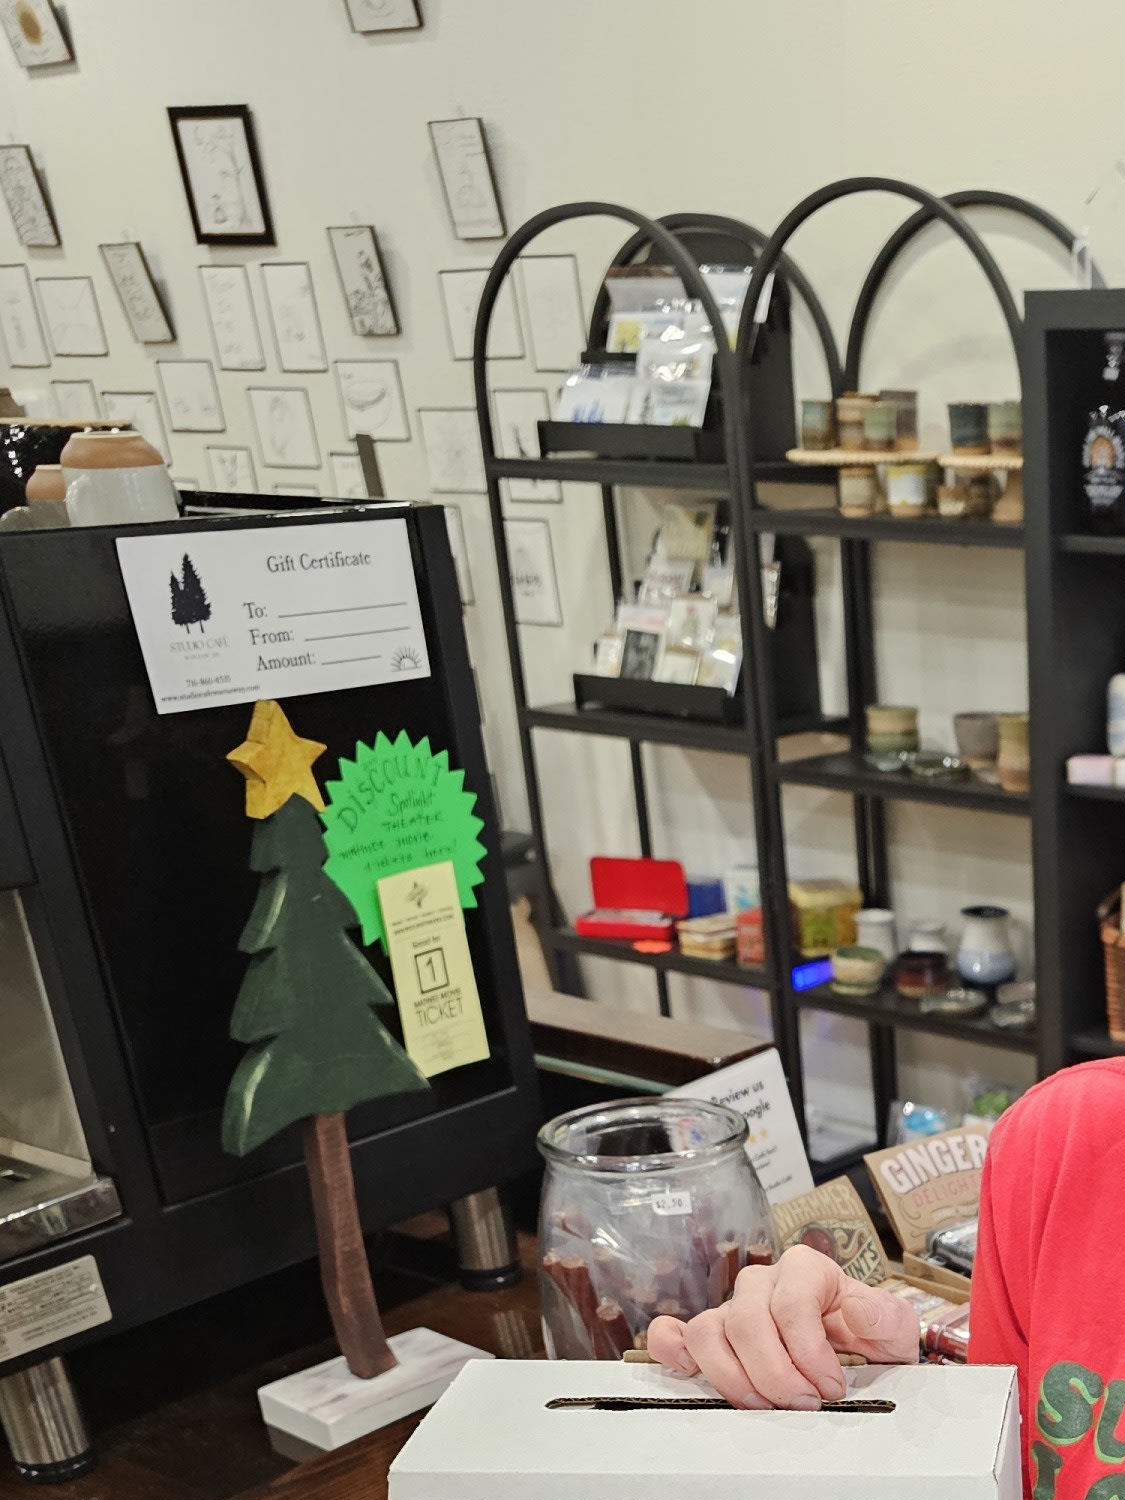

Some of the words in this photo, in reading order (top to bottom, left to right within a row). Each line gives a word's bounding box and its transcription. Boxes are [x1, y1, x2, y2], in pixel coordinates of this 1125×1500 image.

[266, 554, 296, 574] Gift
[299, 551, 371, 571] Certificate
[242, 601, 267, 619] To:
[248, 627, 295, 646] From:
[256, 652, 316, 672] Amount:
[337, 755, 444, 833] DISCOUNT
[426, 957, 437, 982] 1
[415, 997, 464, 1028] TICKET
[753, 1081, 764, 1092] us
[743, 1099, 770, 1119] oogle
[880, 1133, 988, 1195] GINGER
[843, 1240, 879, 1283] INTS
